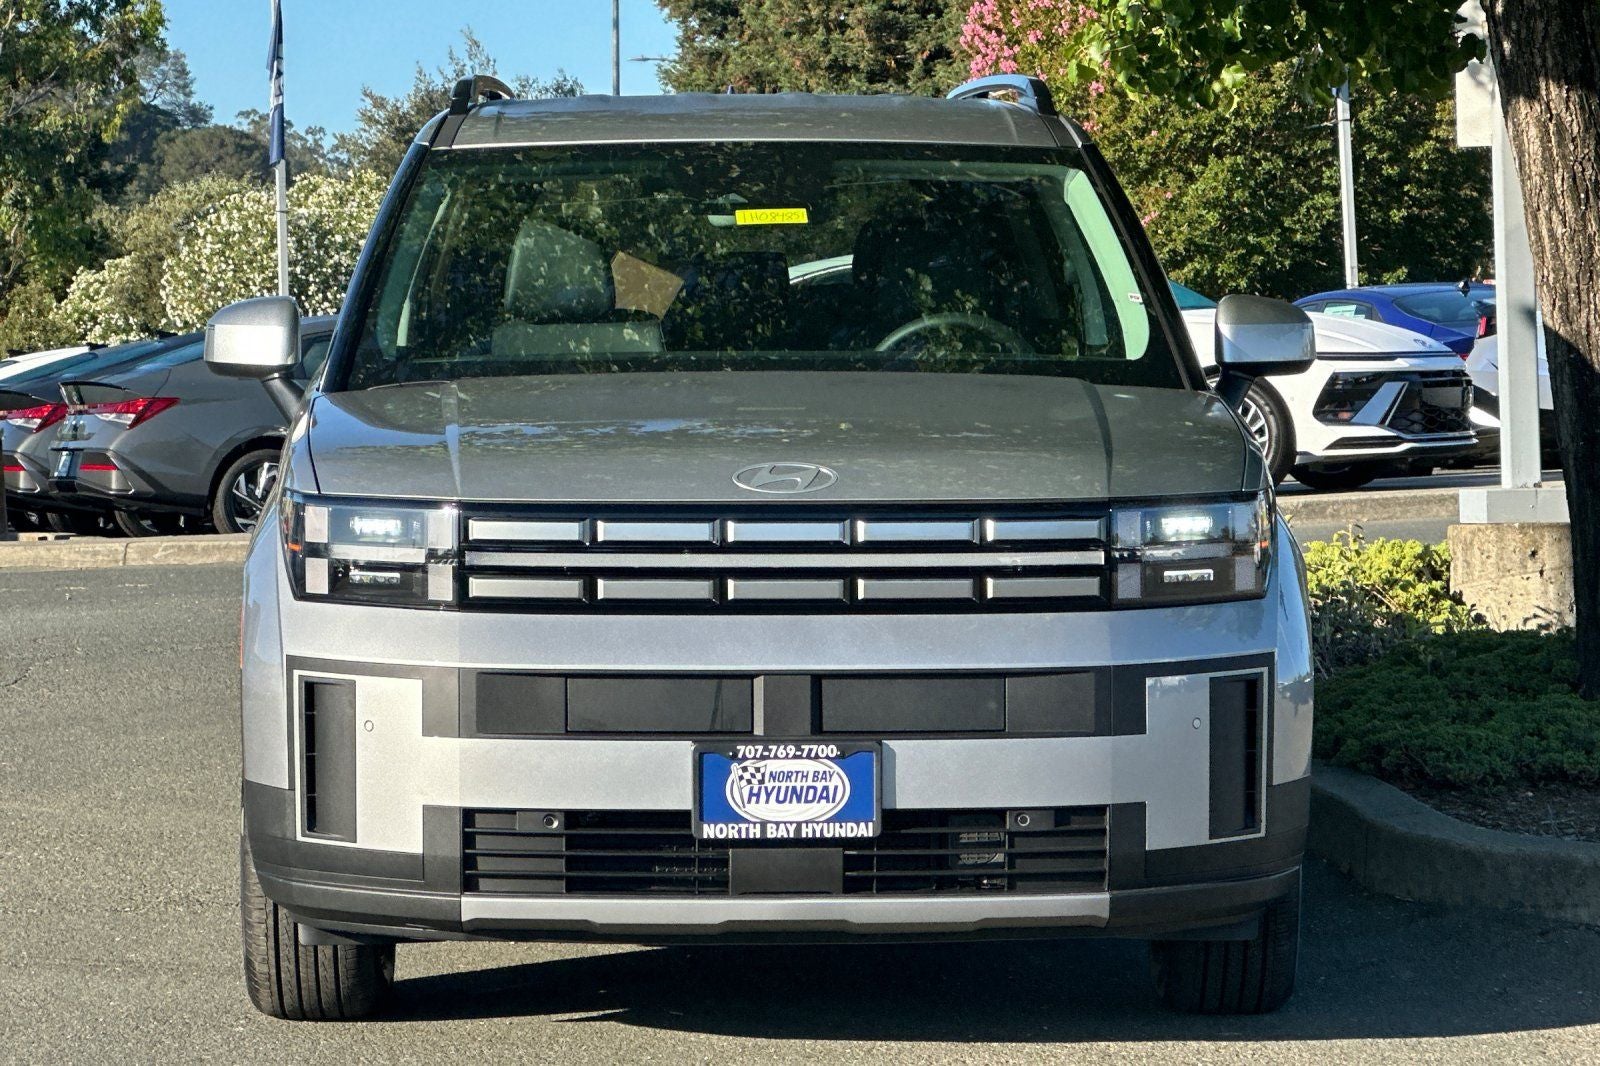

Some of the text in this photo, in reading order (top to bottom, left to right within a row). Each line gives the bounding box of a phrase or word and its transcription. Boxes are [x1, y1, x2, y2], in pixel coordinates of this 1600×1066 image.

[768, 770, 836, 783] NORTH BAY
[746, 785, 838, 805] HYUNDAI
[702, 821, 874, 839] NORTH BAY HYUNDAI
